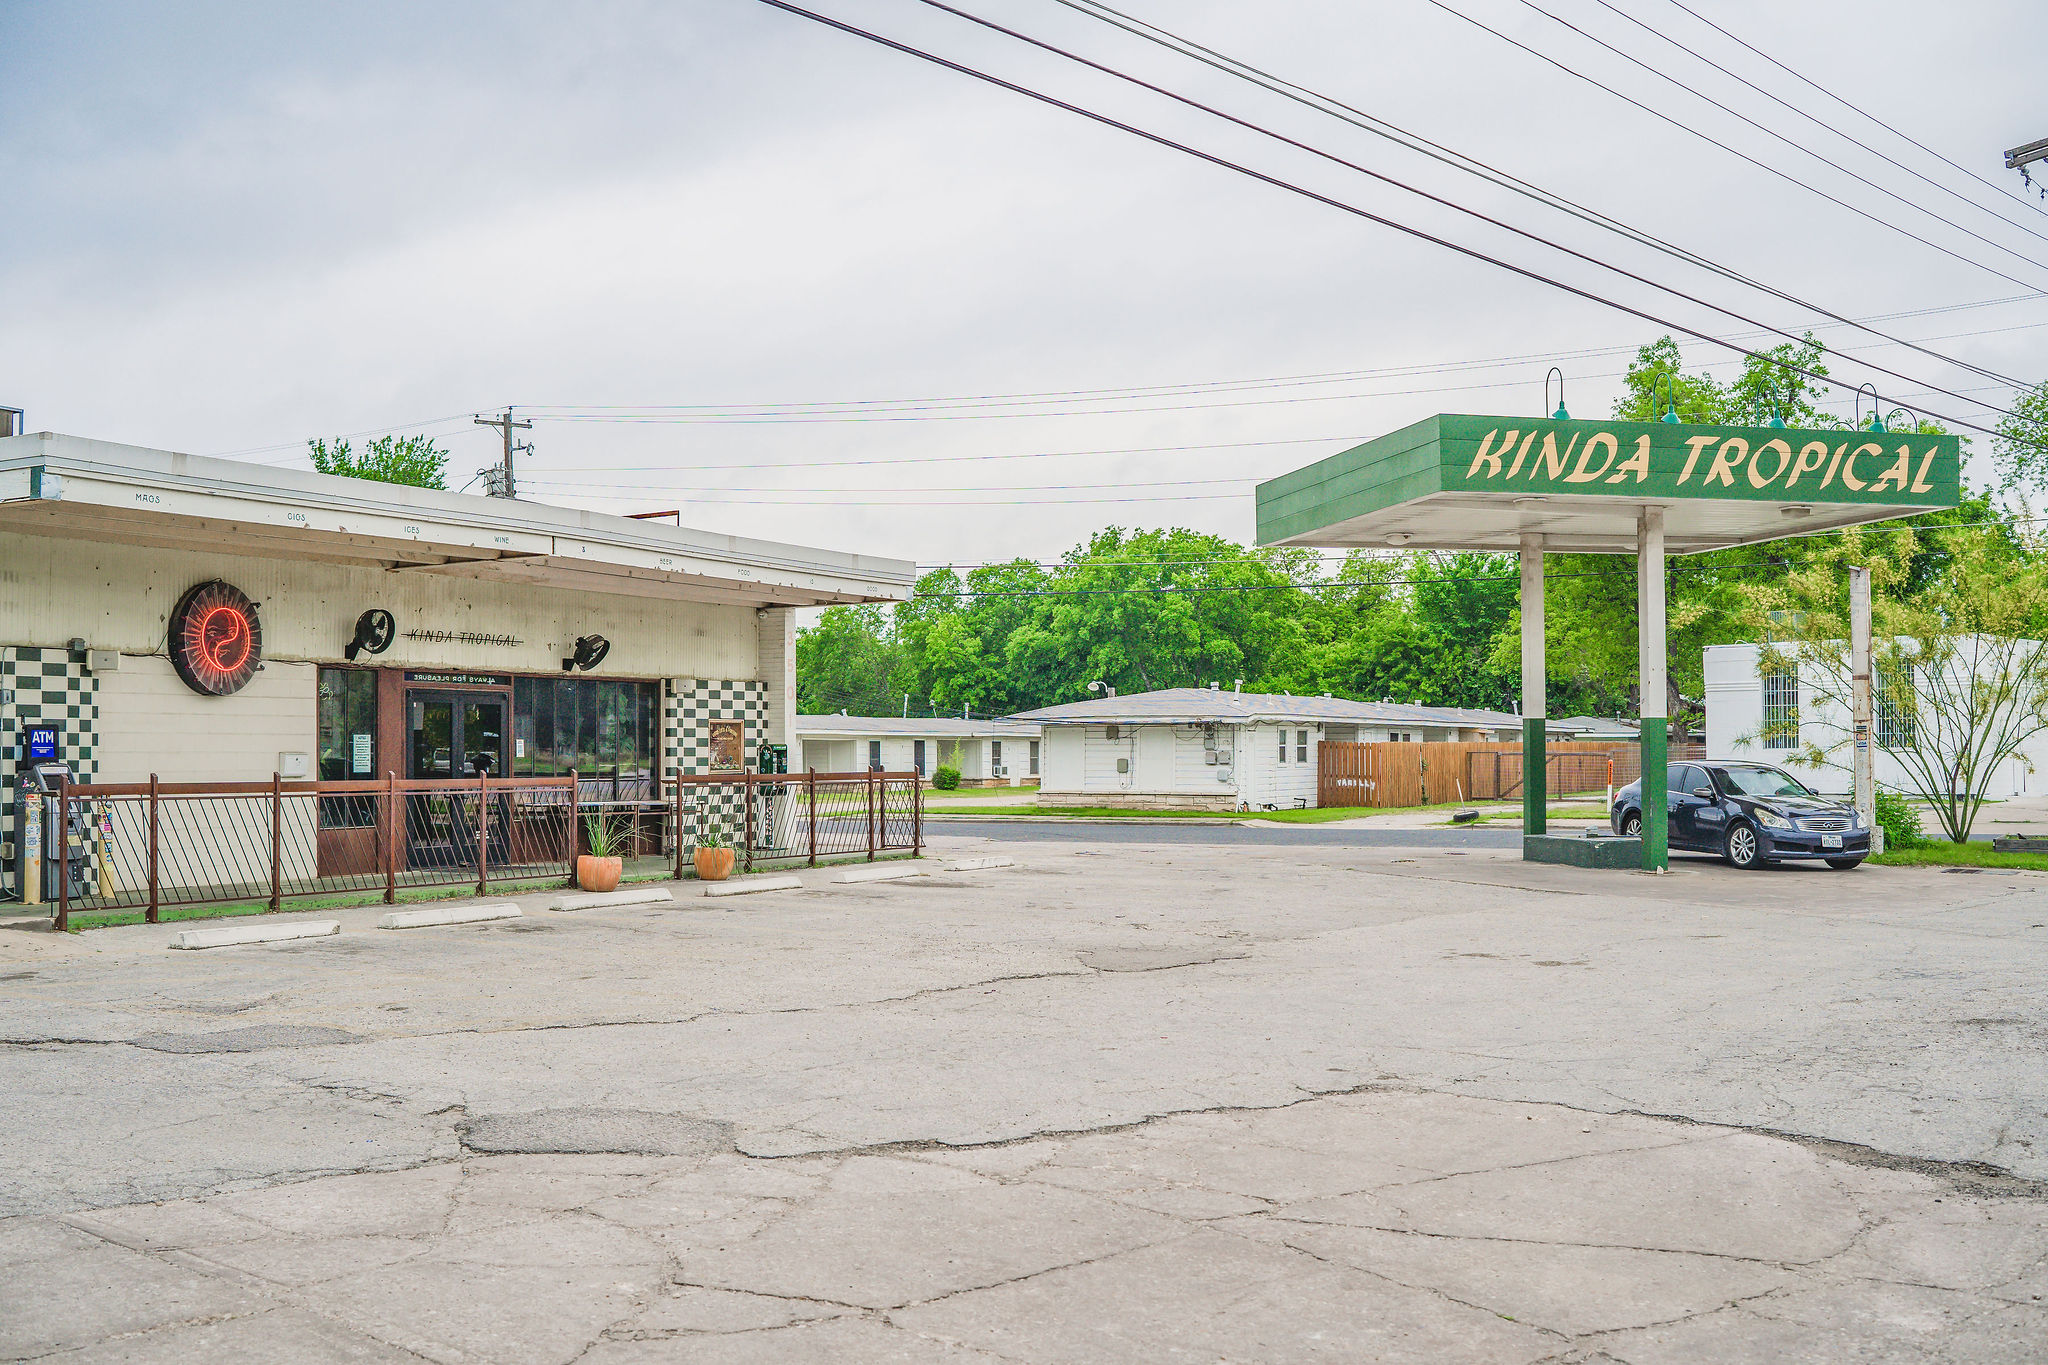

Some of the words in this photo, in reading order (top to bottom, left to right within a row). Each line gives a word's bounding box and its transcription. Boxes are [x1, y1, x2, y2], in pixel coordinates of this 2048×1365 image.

[1466, 428, 1651, 484] KINDA
[1676, 435, 1939, 493] TROPICAL
[135, 493, 160, 504] MAGS
[494, 536, 509, 544] WINE
[410, 628, 453, 643] KINDA
[459, 631, 517, 647] TROPICAL
[32, 731, 54, 743] ATM
